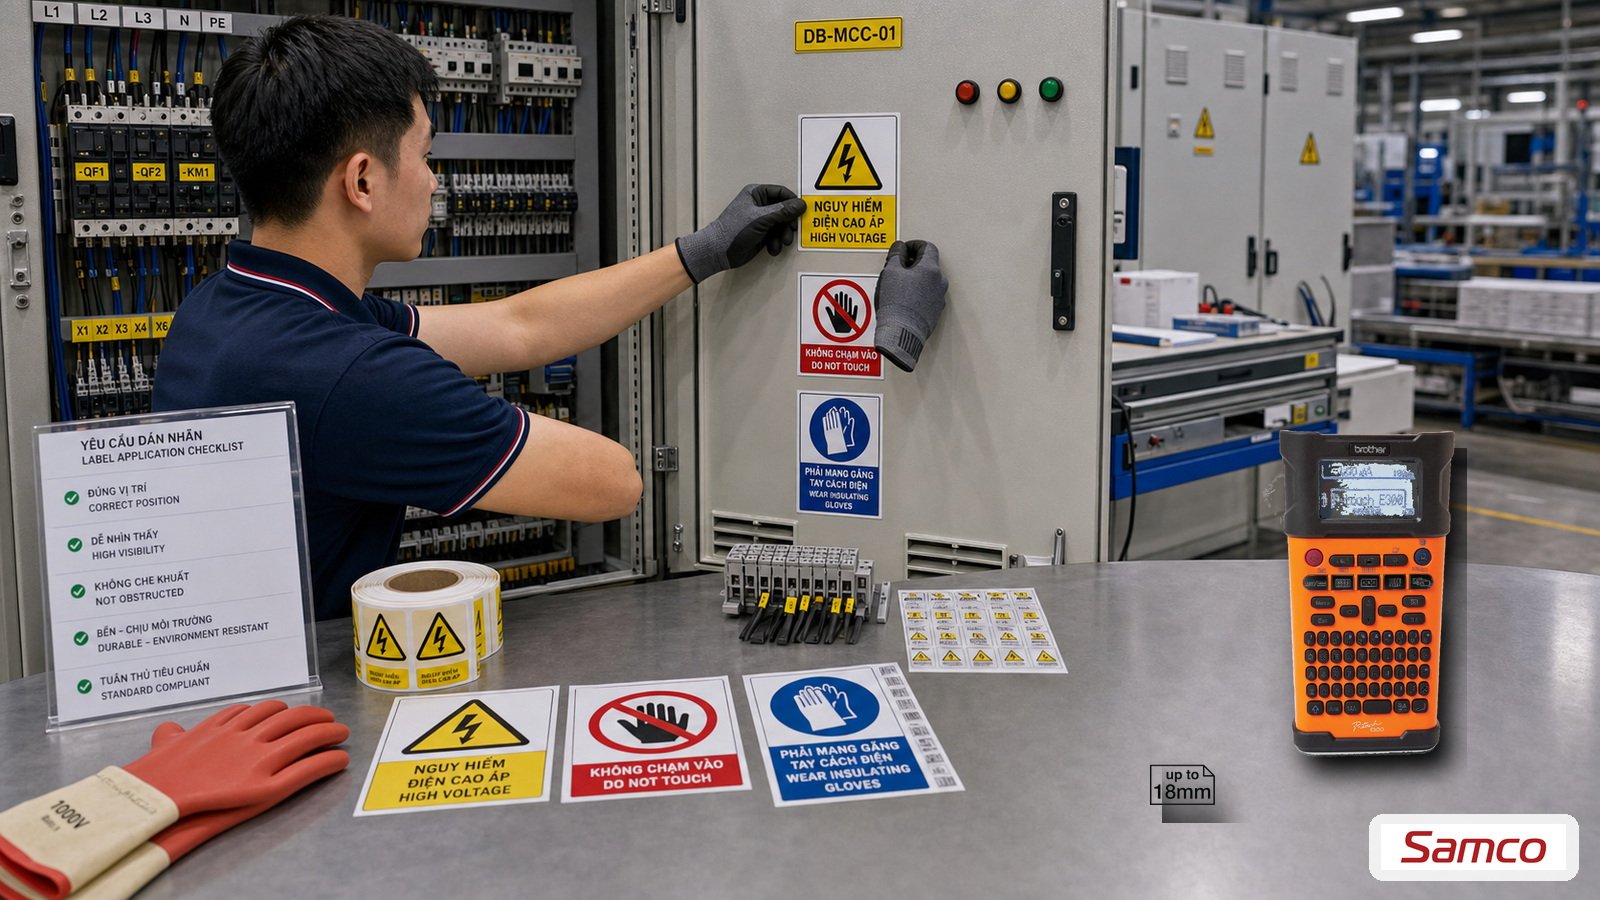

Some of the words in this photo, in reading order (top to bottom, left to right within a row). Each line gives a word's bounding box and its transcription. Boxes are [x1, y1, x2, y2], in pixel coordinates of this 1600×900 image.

[44, 5, 59, 18] L1
[90, 8, 107, 21] L2
[135, 11, 152, 24] L3
[180, 15, 189, 26] N
[209, 17, 226, 28] PE
[803, 25, 895, 44] DB-MCC-01
[78, 166, 105, 178] -QF1
[135, 166, 162, 178] -QF2
[182, 166, 209, 178] -KM1
[814, 200, 848, 213] NGUY
[812, 214, 839, 230] ĐIỆN
[842, 217, 866, 228] CAO
[869, 215, 885, 228] ÁP
[810, 233, 836, 242] HIGH
[839, 233, 887, 243] VOLTAGE
[76, 325, 89, 336] X1
[95, 324, 109, 335] X2
[115, 323, 128, 334] X3
[134, 322, 147, 333] X4
[155, 321, 168, 332] X6
[835, 350, 859, 361] CHẠM
[811, 361, 822, 370] DO
[824, 362, 841, 370] NOT
[842, 362, 870, 372] TOUCH
[81, 438, 106, 451] YÊU
[138, 431, 165, 446] DÁN
[82, 453, 115, 466] LABEL
[117, 447, 185, 463] APPLICATION
[188, 441, 244, 456] CHECKLIST
[1354, 445, 1386, 454] brother
[825, 469, 849, 478] MANG
[118, 485, 129, 497] VỊ
[131, 482, 147, 494] TRÍ
[809, 479, 824, 487] TAY
[825, 479, 847, 489] CÁCH
[809, 490, 828, 498] WEAR
[88, 499, 133, 513] CORRECT
[136, 495, 180, 508] POSITION
[825, 501, 853, 510] GLOVES
[92, 549, 116, 560] HIGH
[118, 544, 165, 557] VISIBILITY
[134, 575, 154, 587] CHE
[95, 595, 116, 606] NOT
[119, 587, 184, 603] OBSTRUCTED
[98, 638, 143, 653] DURABLE
[153, 628, 219, 646] ENVIRONMENT
[222, 621, 269, 636] RESISTANT
[101, 685, 153, 701] STANDARD
[155, 677, 210, 693] COMPLIANT
[780, 744, 813, 759] PHẢI
[816, 744, 857, 757] MANG
[590, 761, 643, 778] KHÔNG
[647, 760, 690, 775] CHẠM
[694, 757, 724, 770] VÀO
[790, 759, 816, 771] TAY
[819, 754, 858, 768] CÁCH
[862, 751, 893, 766] ĐIỆN
[414, 762, 460, 775] NGUY
[786, 770, 827, 784] WEAR
[829, 764, 911, 780] INSULATING
[407, 776, 446, 790] ĐIỆN
[451, 774, 484, 785] CAO
[488, 770, 511, 782] ÁP
[603, 779, 624, 790] DO
[628, 777, 658, 788] NOT
[661, 773, 712, 786] TOUCH
[824, 778, 881, 793] GLOVES
[399, 791, 438, 803] HIGH
[443, 785, 511, 799] VOLTAGE
[50, 799, 91, 829] 1000V
